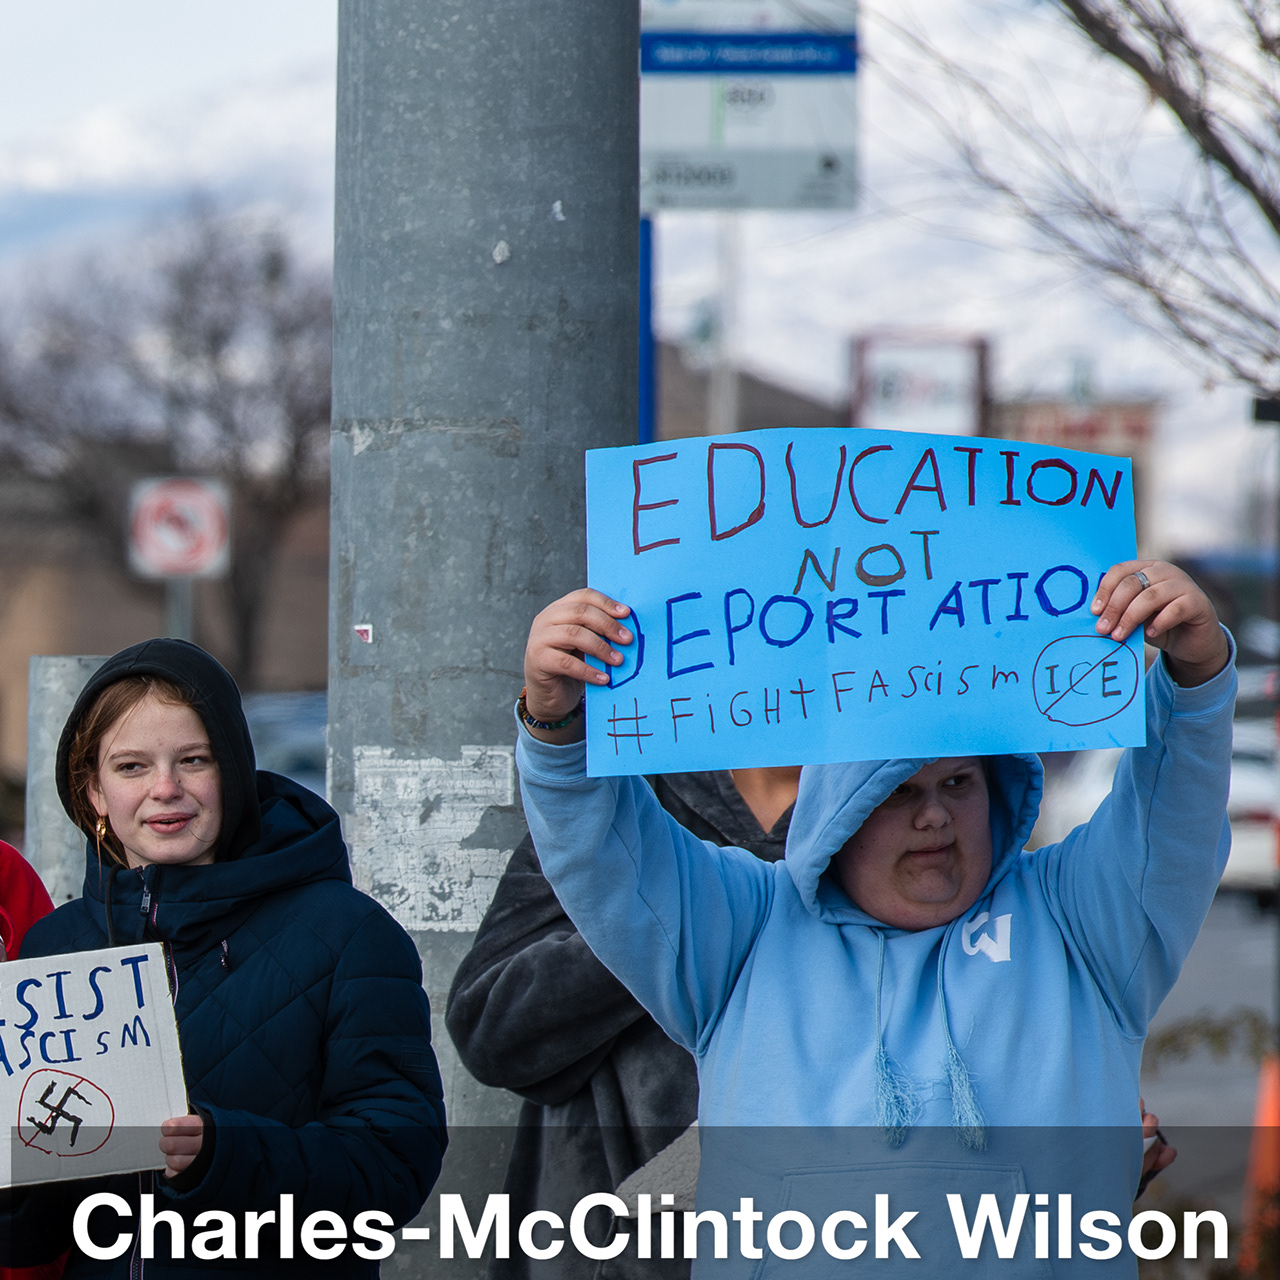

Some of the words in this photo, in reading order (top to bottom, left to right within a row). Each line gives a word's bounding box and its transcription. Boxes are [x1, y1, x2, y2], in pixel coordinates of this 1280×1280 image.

[632, 442, 1124, 556] EDUCATION
[793, 530, 941, 596] NOT
[605, 564, 1107, 690] DEPORTATIO
